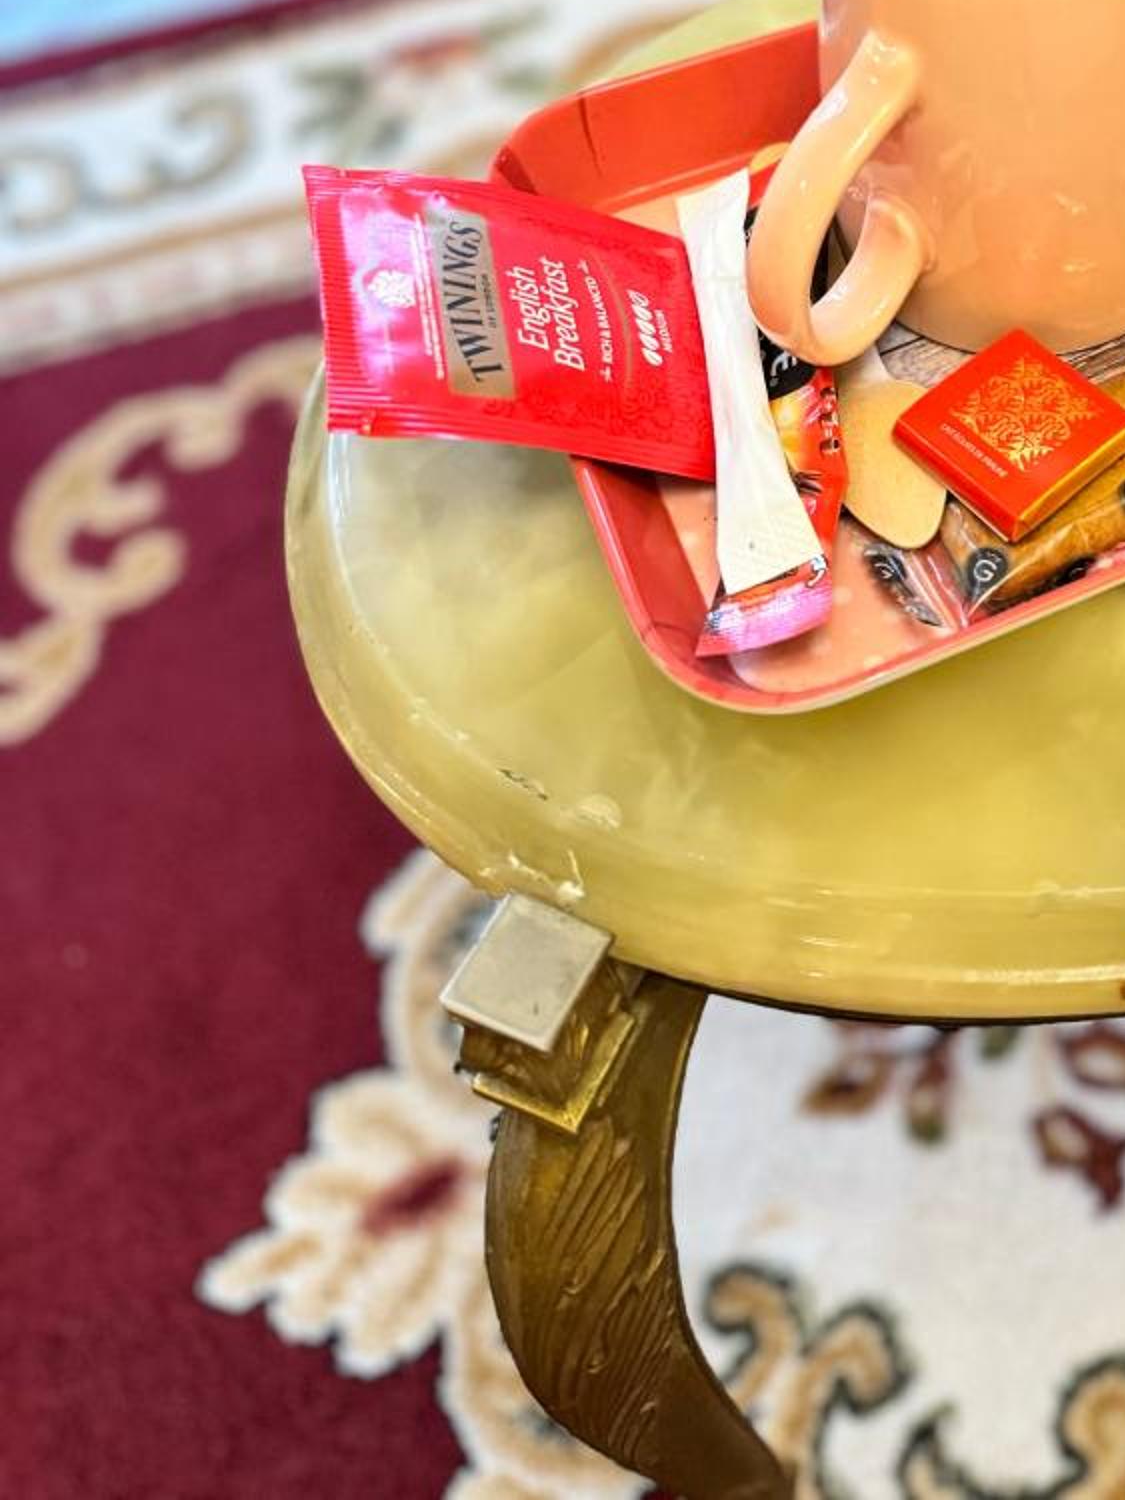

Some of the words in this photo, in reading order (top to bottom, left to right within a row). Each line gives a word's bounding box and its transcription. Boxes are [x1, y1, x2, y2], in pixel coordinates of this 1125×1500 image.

[442, 221, 504, 382] TWININGS
[506, 265, 550, 351] English
[538, 255, 585, 372] Breakfast
[584, 276, 610, 329] BALANCED
[973, 559, 998, 582] G
